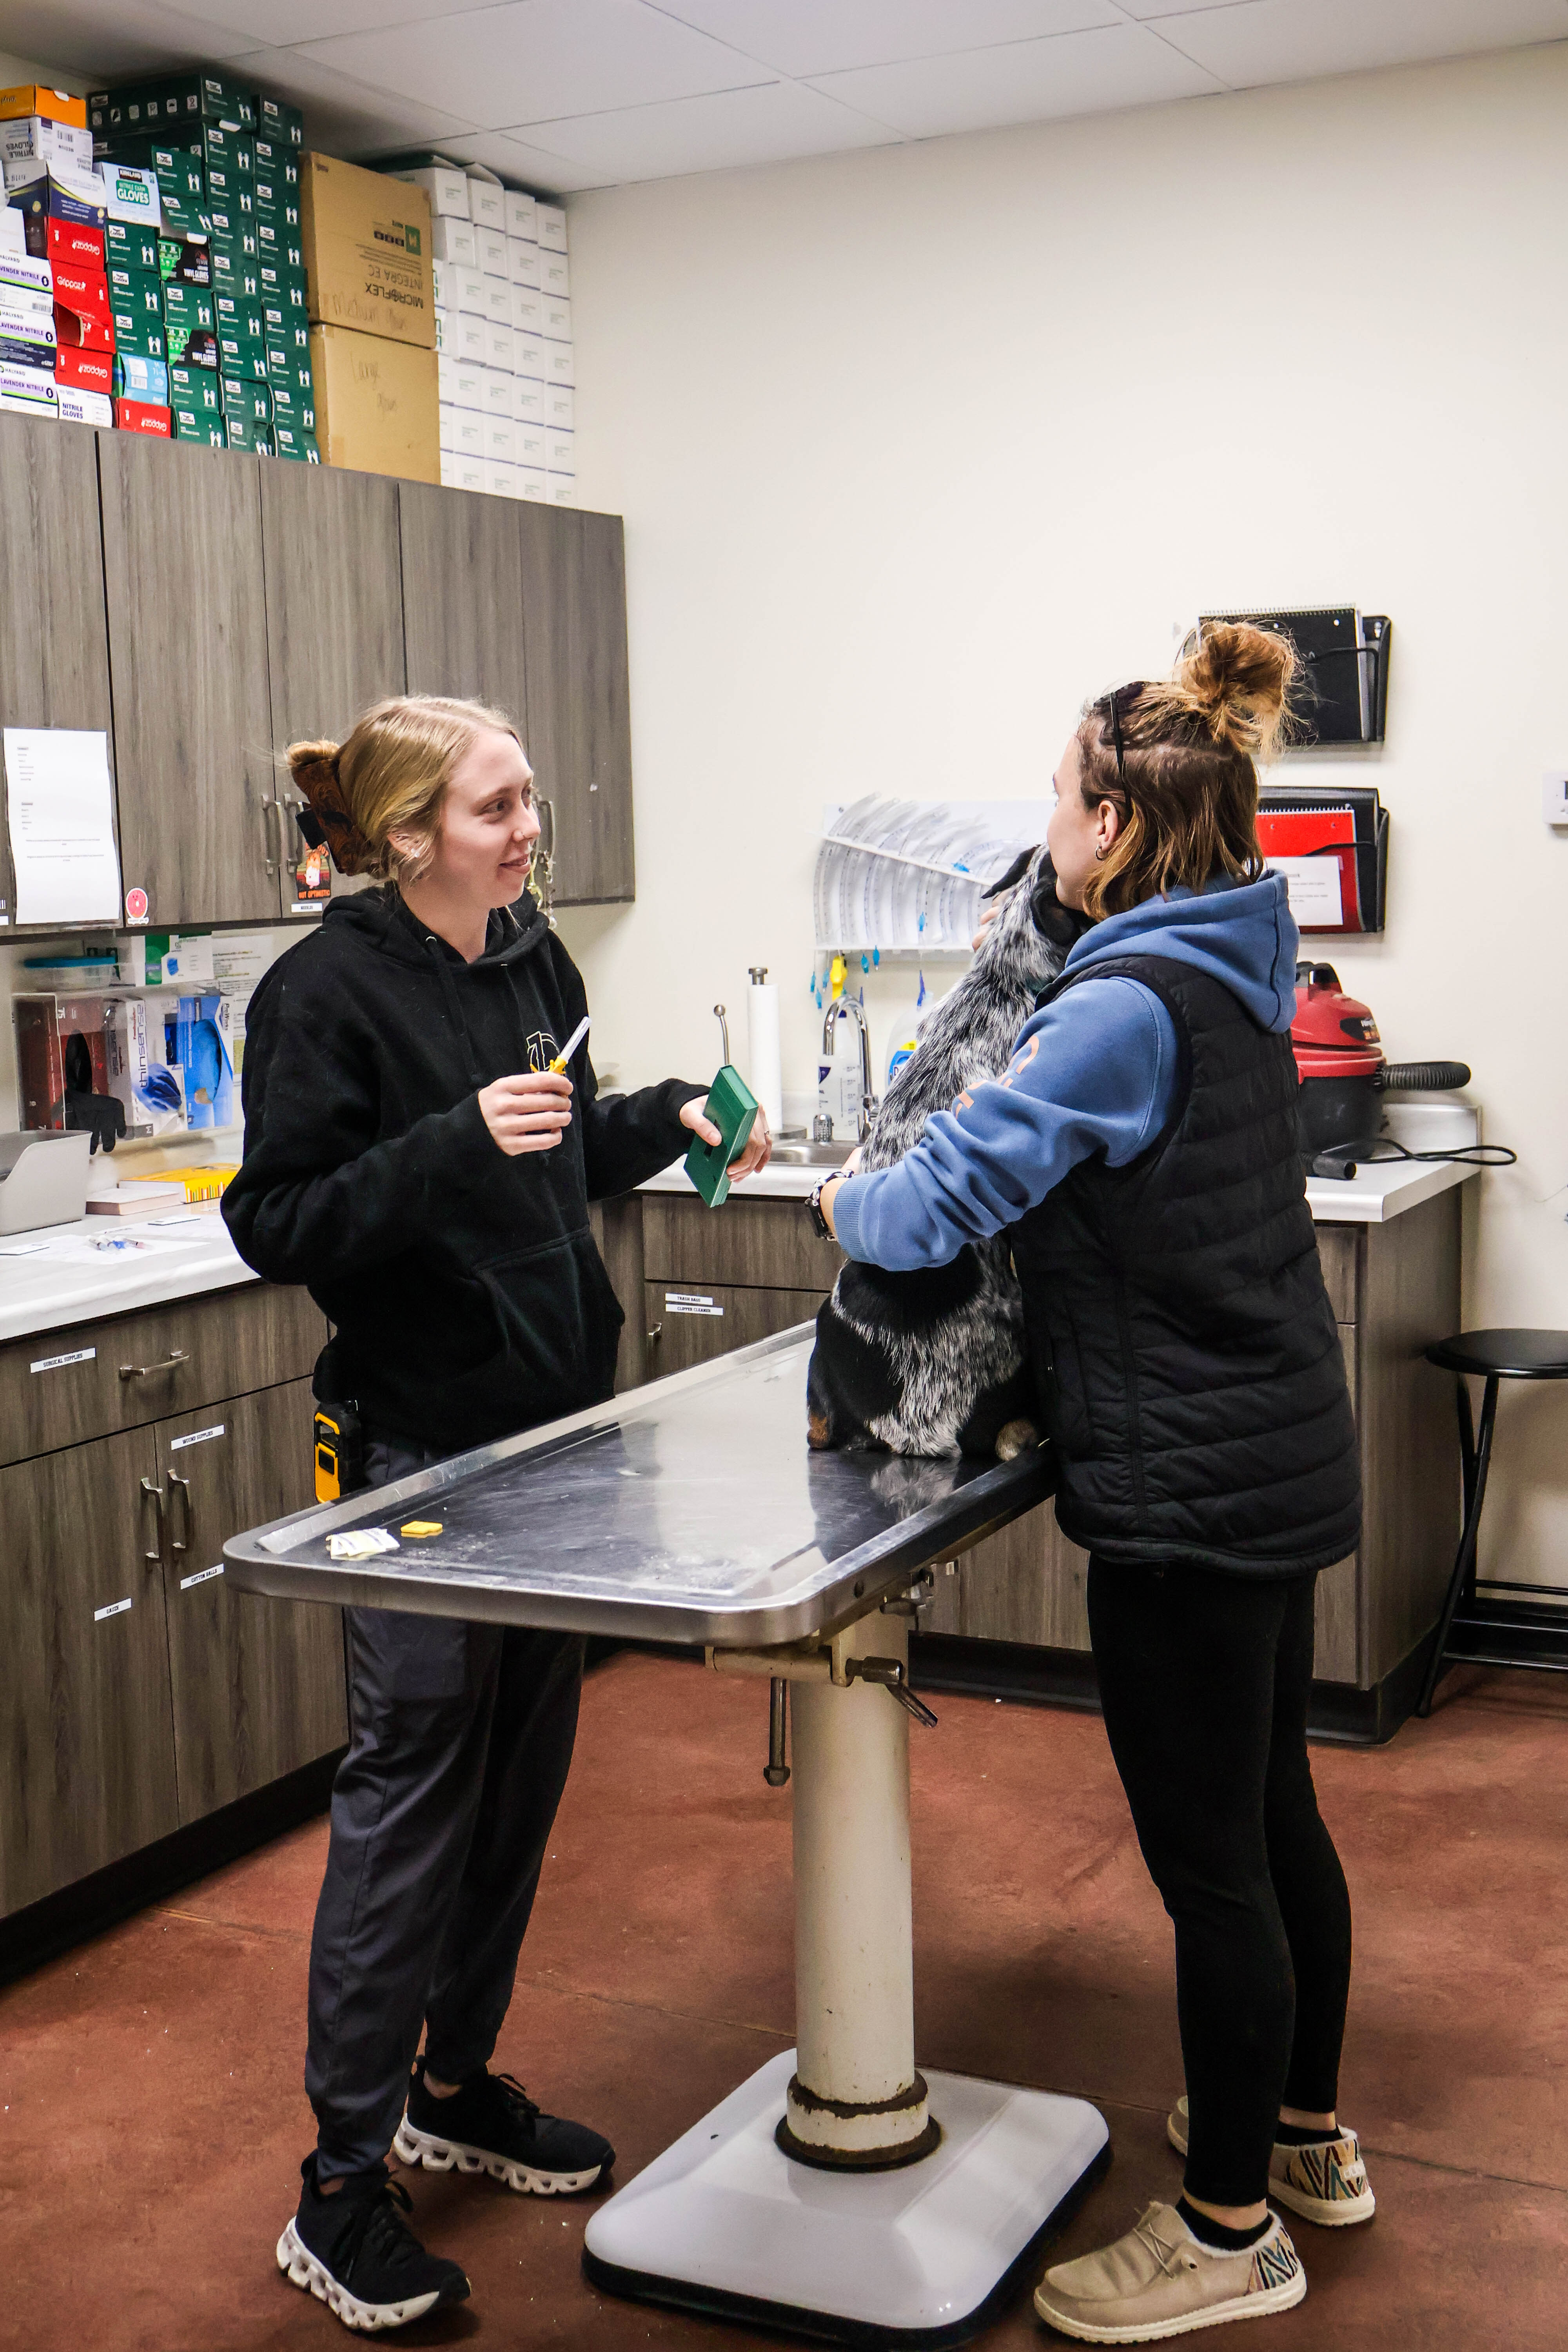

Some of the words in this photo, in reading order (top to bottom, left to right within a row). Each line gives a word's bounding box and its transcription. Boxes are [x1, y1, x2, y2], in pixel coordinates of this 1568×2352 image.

[118, 188, 149, 204] GLOVES
[21, 270, 39, 280] NITRILE
[368, 264, 381, 279] EC
[384, 269, 423, 290] INTEGRA
[25, 327, 44, 336] NITRILE
[83, 365, 108, 379] Grippaz
[0, 378, 25, 388] LAVENDER
[27, 383, 44, 392] NITRILE
[62, 402, 83, 412] NITRILE
[62, 410, 83, 419] GLOVES
[145, 419, 167, 432] Grippaz
[137, 1004, 148, 1089] thinsense
[43, 1359, 63, 1367] SURGICAL
[64, 1353, 83, 1362] SUPPLIES
[182, 1436, 196, 1445] WOUND
[197, 1431, 213, 1440] SUPPLIES
[191, 1573, 205, 1583] COTTON
[206, 1568, 217, 1577] BALLS
